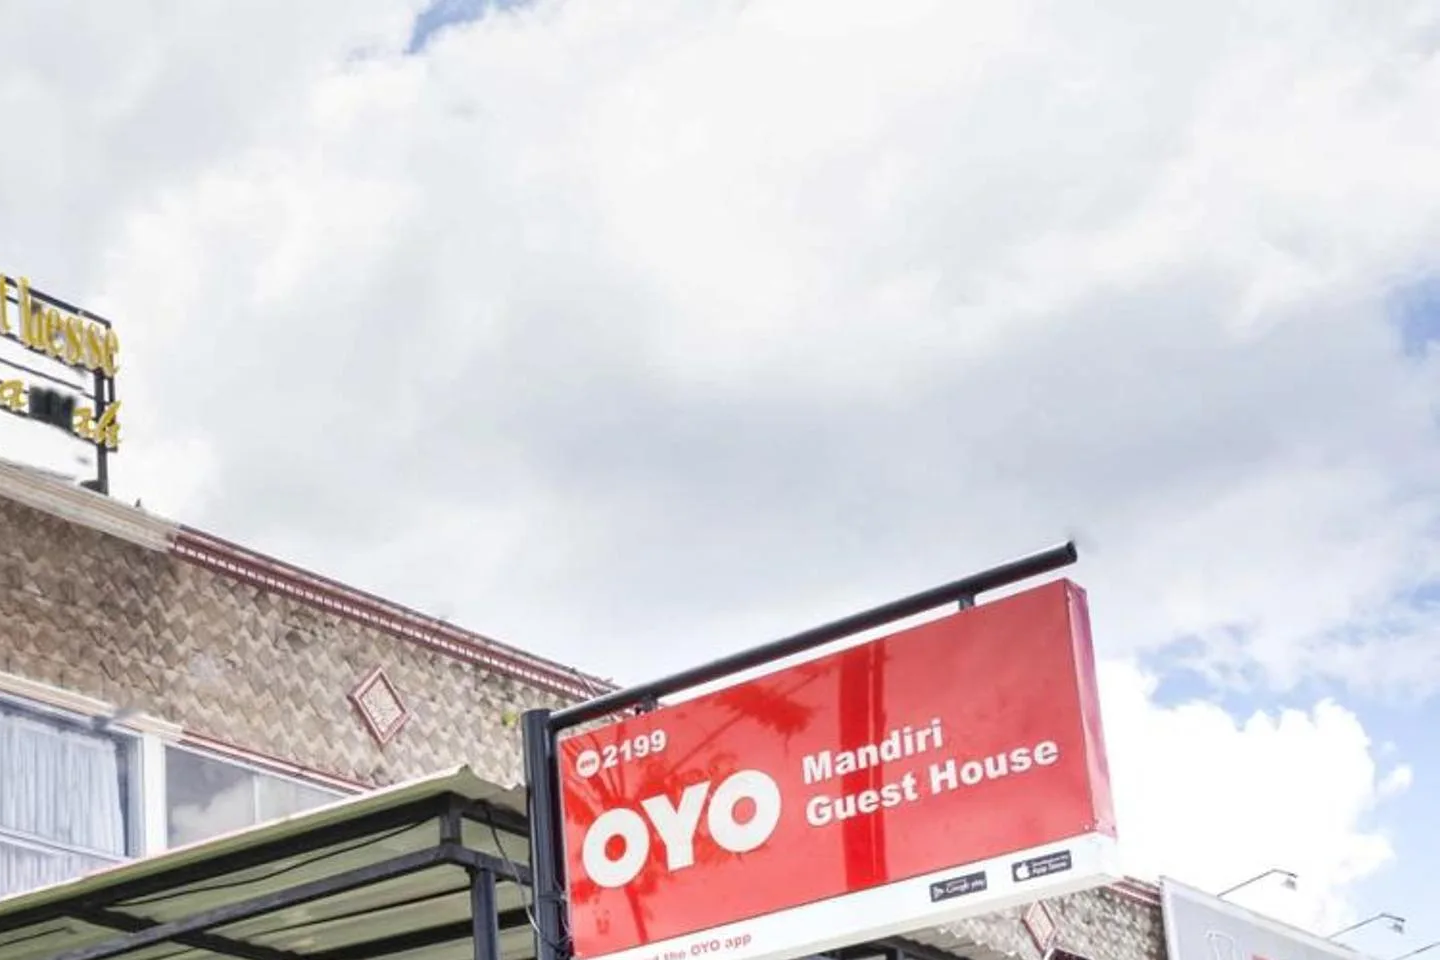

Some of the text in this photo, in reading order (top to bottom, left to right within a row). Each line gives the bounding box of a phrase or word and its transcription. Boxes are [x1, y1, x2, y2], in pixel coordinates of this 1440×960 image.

[602, 729, 666, 769] 2199
[802, 718, 943, 784] Mandiri
[806, 739, 1059, 828] Guest House
[582, 769, 781, 888] OYO
[690, 939, 721, 957] OYO
[725, 933, 752, 950] app
